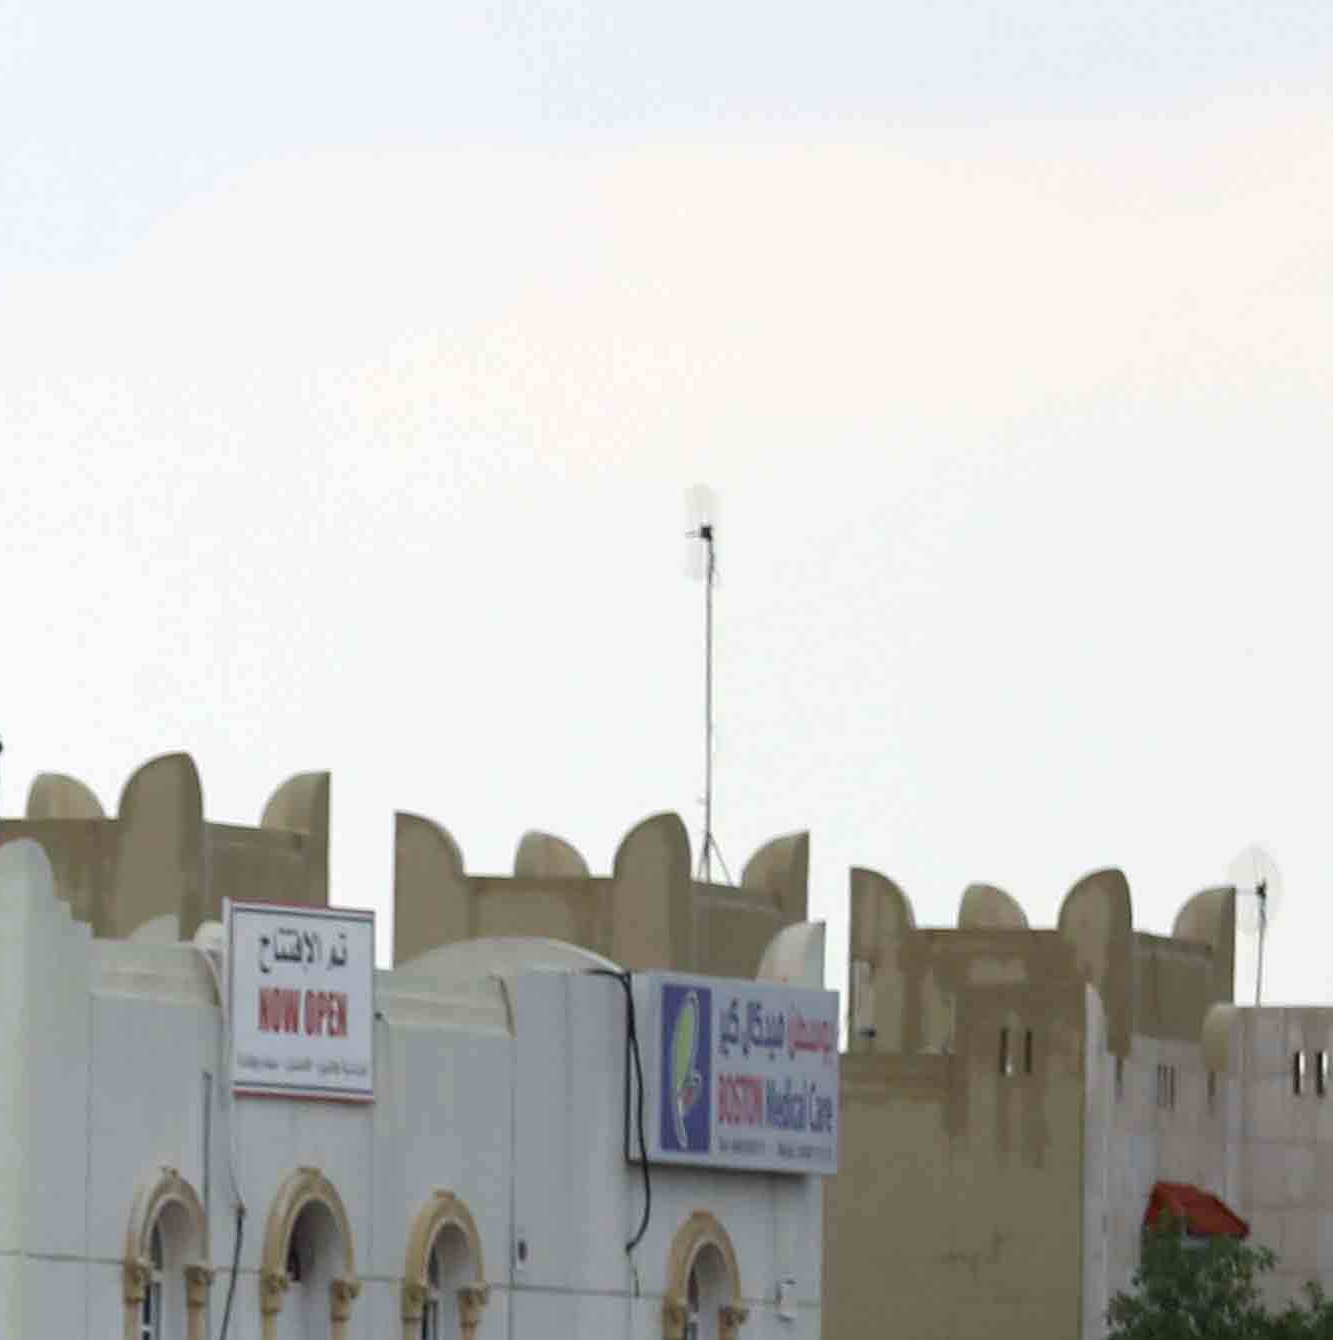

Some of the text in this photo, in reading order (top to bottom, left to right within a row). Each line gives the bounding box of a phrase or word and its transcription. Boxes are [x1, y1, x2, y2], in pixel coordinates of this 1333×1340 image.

[259, 987, 347, 1036] NOW OPEN
[717, 1071, 834, 1133] BOSTON Medical Care
